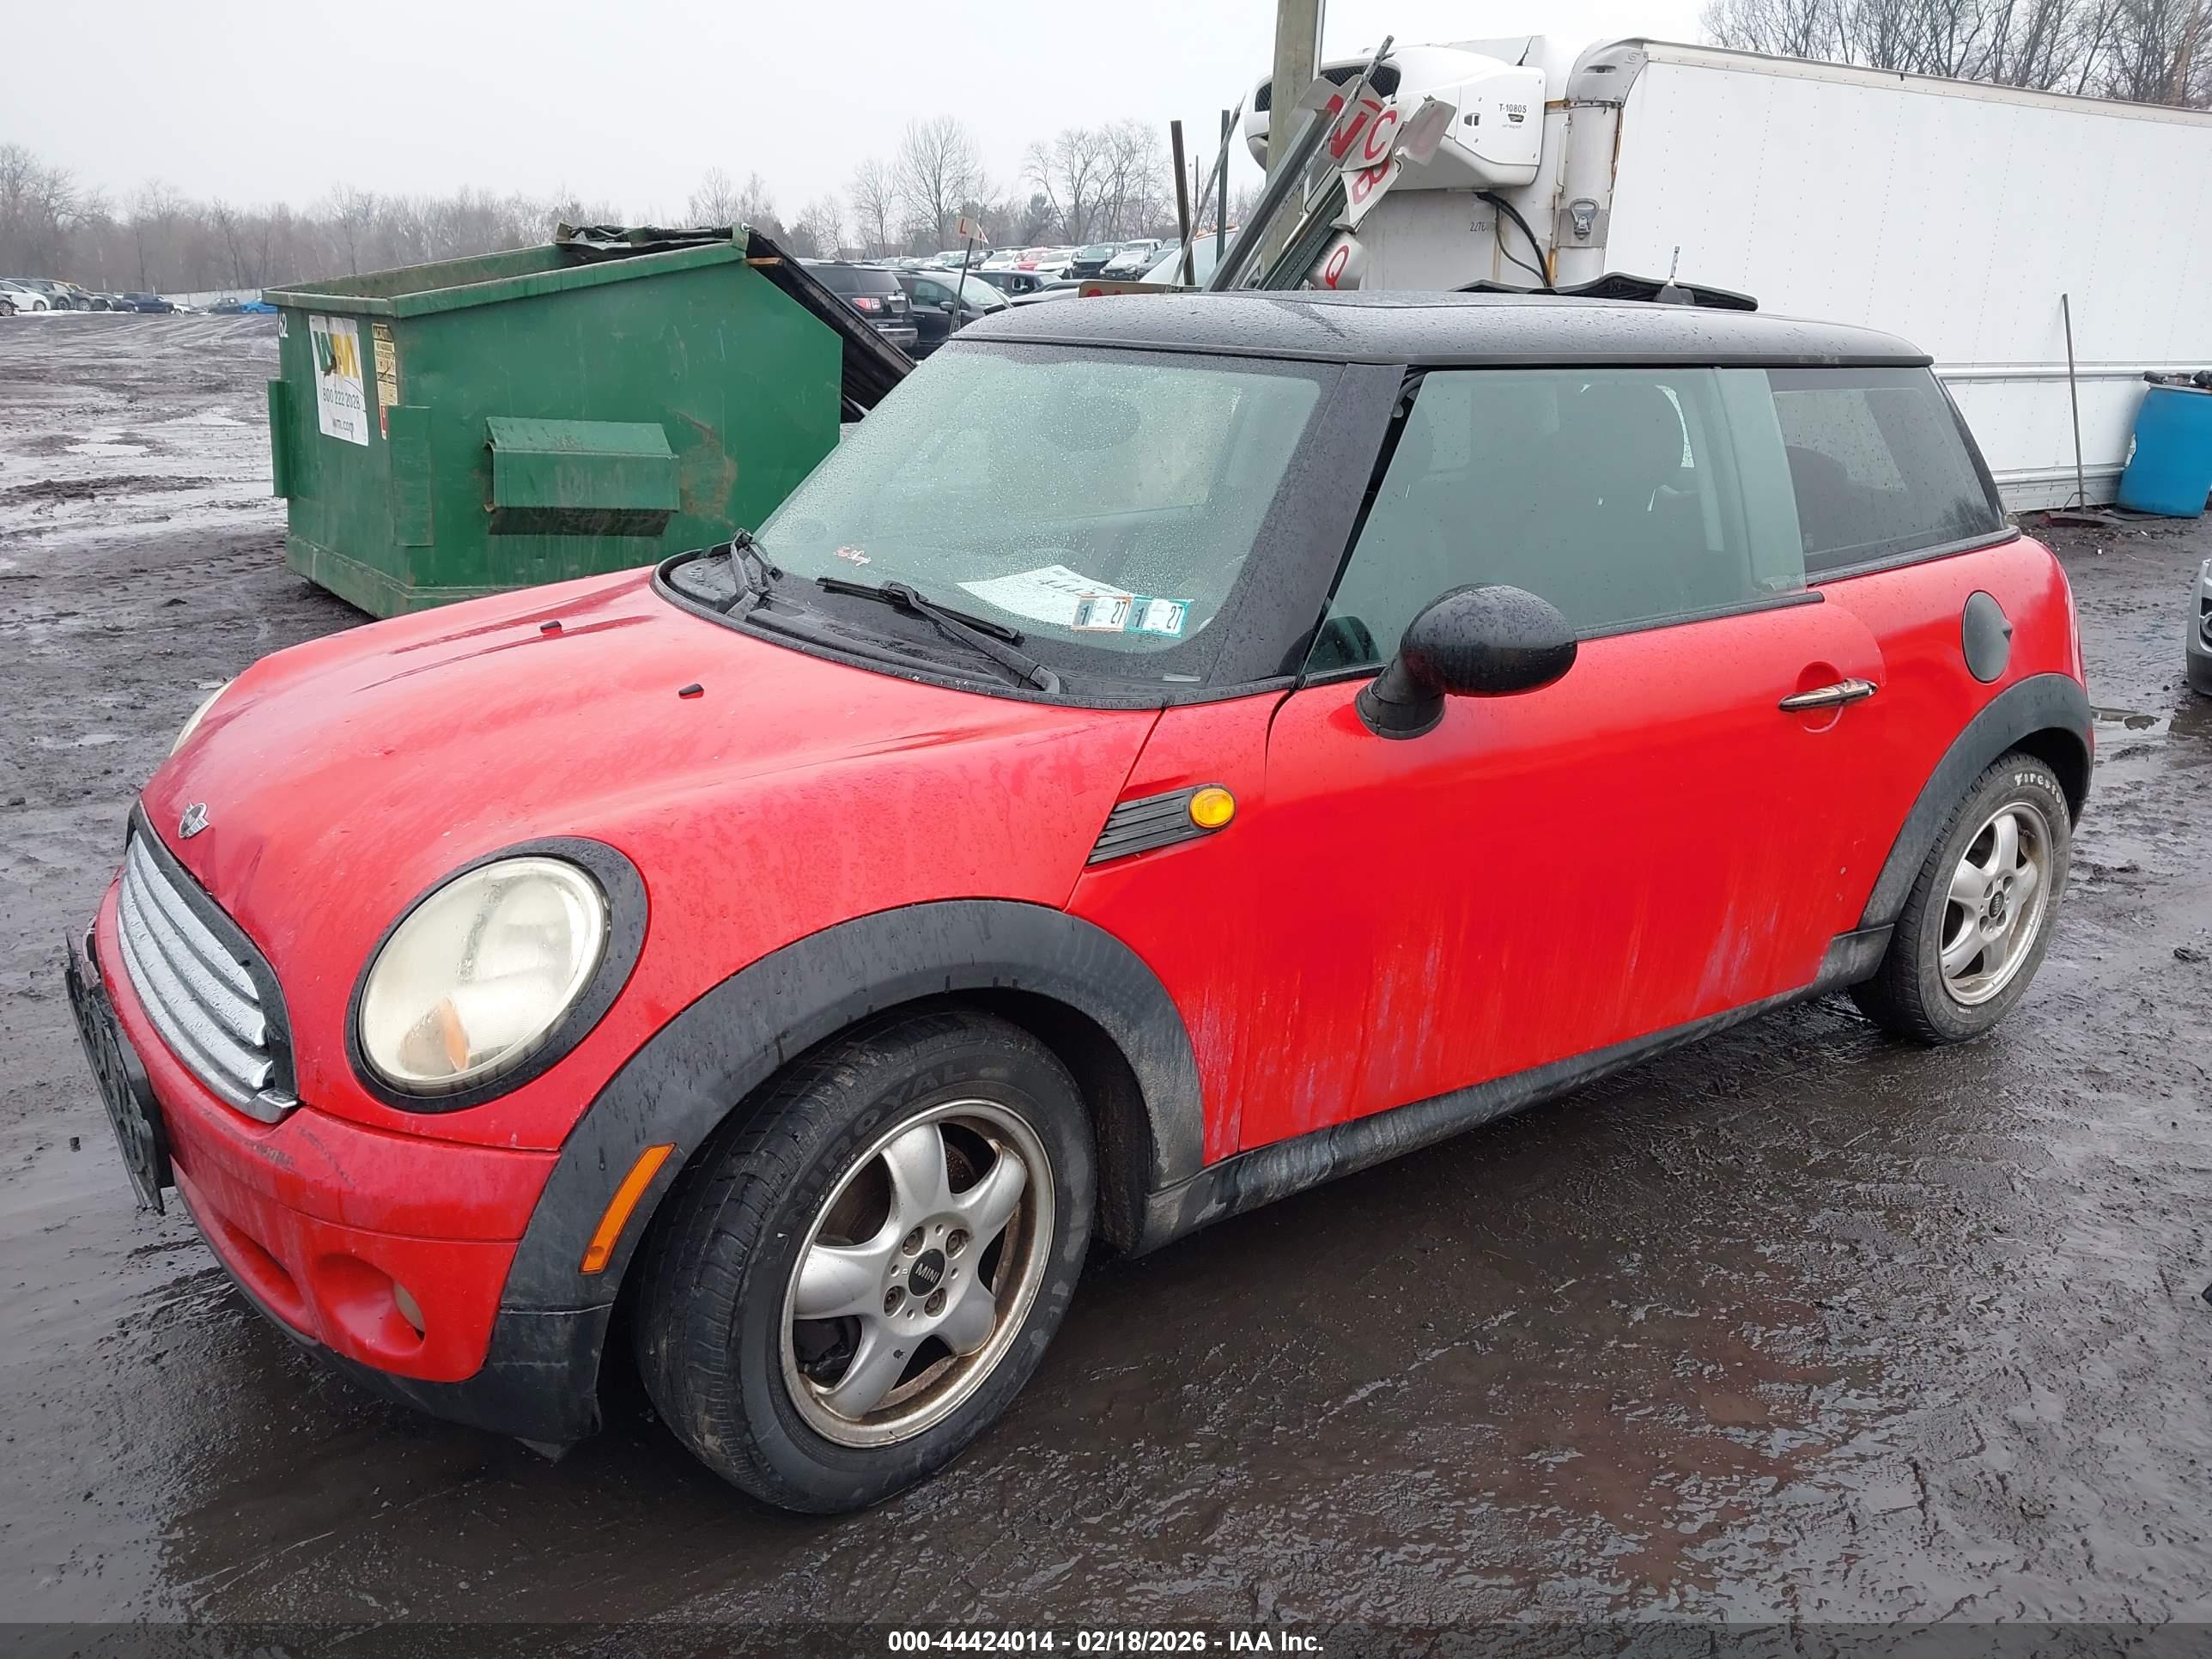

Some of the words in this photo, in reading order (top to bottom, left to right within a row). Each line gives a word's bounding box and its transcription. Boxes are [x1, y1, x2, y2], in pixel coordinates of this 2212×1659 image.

[1498, 103, 1527, 113] T-1080S
[279, 313, 289, 338] 62
[322, 387, 333, 403] 800
[335, 391, 345, 406] 222
[1110, 601, 1127, 624] 27
[1167, 605, 1183, 629] 27
[2014, 773, 2069, 826] Firestone
[915, 1262, 940, 1284] MINI
